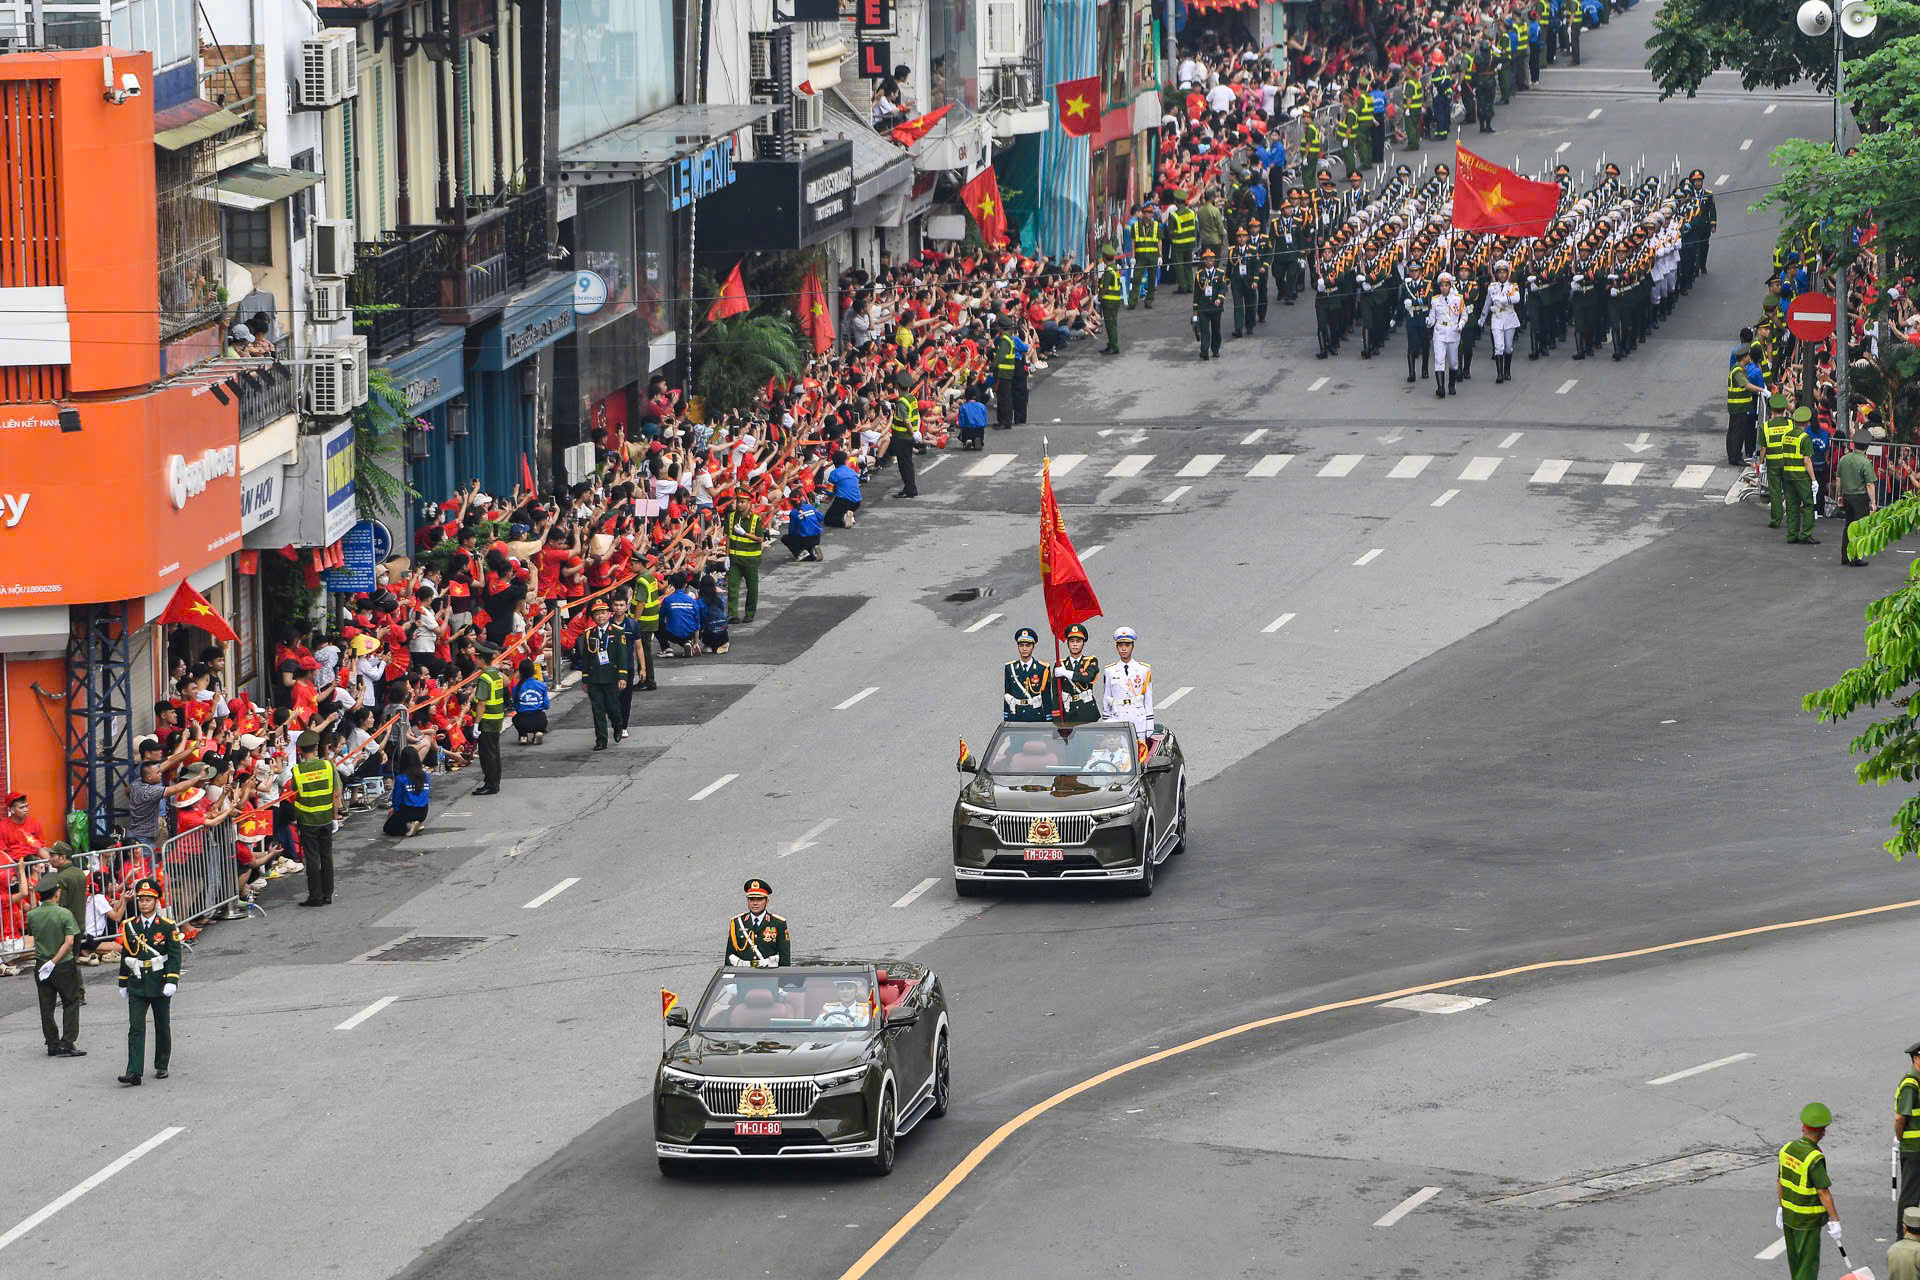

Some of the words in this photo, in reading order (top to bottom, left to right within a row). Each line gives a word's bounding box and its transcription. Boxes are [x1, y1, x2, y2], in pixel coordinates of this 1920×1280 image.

[579, 277, 591, 293] 9
[2, 418, 20, 429] LIÊN
[22, 416, 38, 428] KẾT
[1025, 850, 1063, 860] TM-02-80
[736, 1122, 780, 1134] TM-01-80
